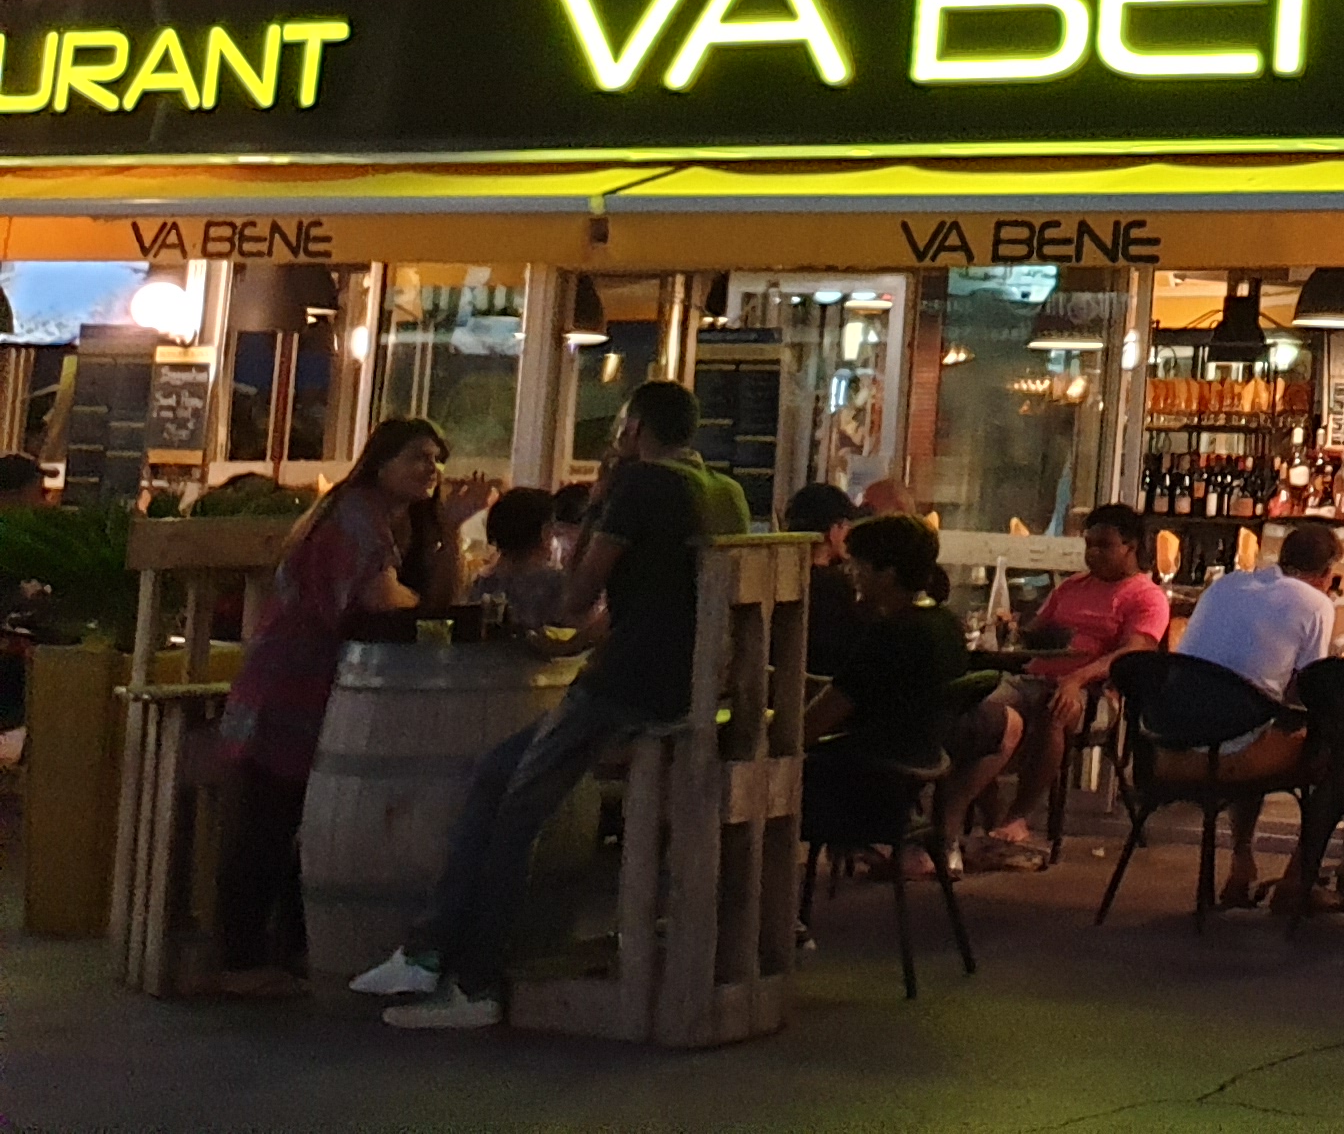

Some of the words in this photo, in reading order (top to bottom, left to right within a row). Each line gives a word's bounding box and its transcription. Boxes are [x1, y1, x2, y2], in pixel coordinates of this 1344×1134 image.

[131, 220, 187, 259] VA
[201, 219, 333, 259] BENE
[901, 219, 975, 264] VA
[990, 218, 1162, 264] BENE
